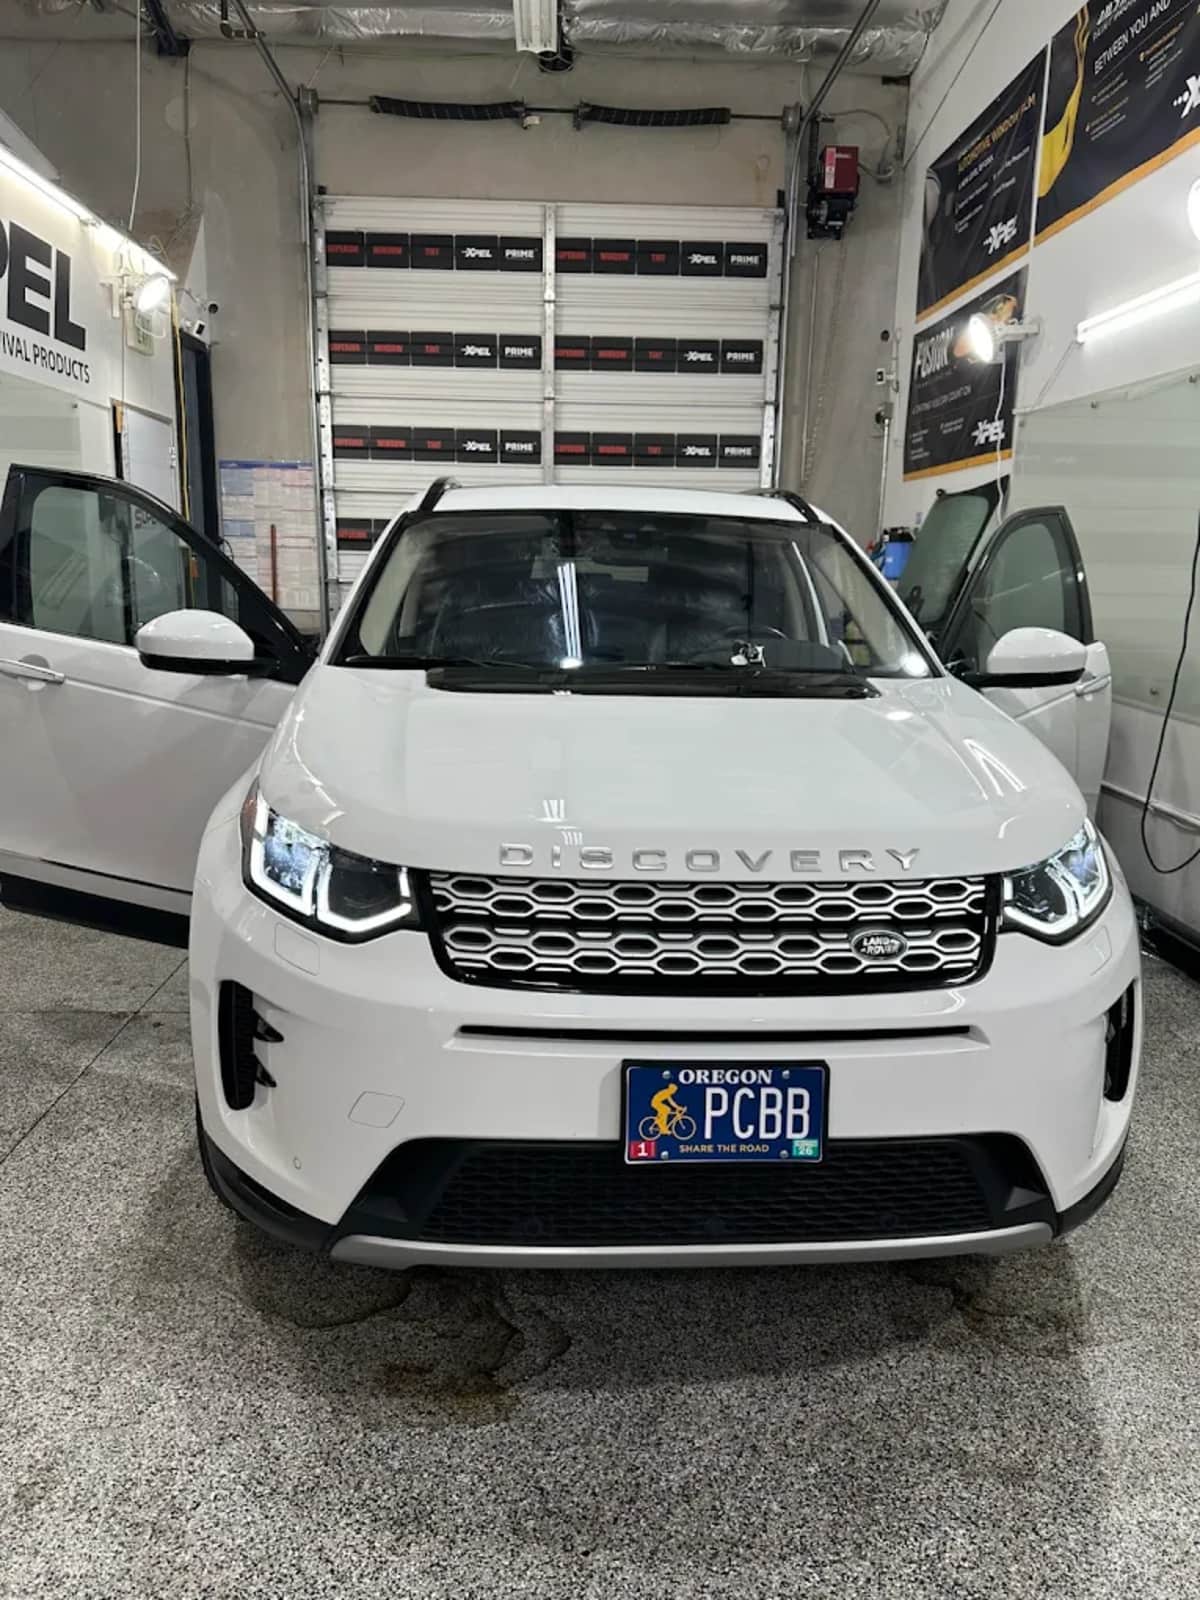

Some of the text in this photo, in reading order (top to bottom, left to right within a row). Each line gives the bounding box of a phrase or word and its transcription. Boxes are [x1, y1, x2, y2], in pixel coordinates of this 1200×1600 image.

[1094, 30, 1129, 76] BETWEEN
[1129, 12, 1149, 38] YOU
[461, 247, 493, 258] XPEL
[505, 248, 534, 259] PRIME
[688, 254, 718, 264] XPEL
[730, 255, 759, 265] PRIME
[0, 219, 86, 352] EL
[461, 345, 491, 356] XPEL
[505, 346, 533, 357] PRIME
[684, 351, 713, 361] XPEL
[726, 352, 755, 361] PRIME
[33, 343, 91, 384] PRODUCTS
[463, 440, 492, 451] XPEL
[505, 442, 534, 452] PRIME
[683, 446, 711, 456] XPEL
[724, 446, 752, 456] PRIME
[500, 843, 920, 873] DISCOVERY
[863, 936, 890, 946] LAND
[678, 1069, 773, 1085] OREGON
[704, 1087, 811, 1140] PCBB
[637, 1142, 648, 1156] 1
[680, 1144, 770, 1153] SHARE THE ROAD
